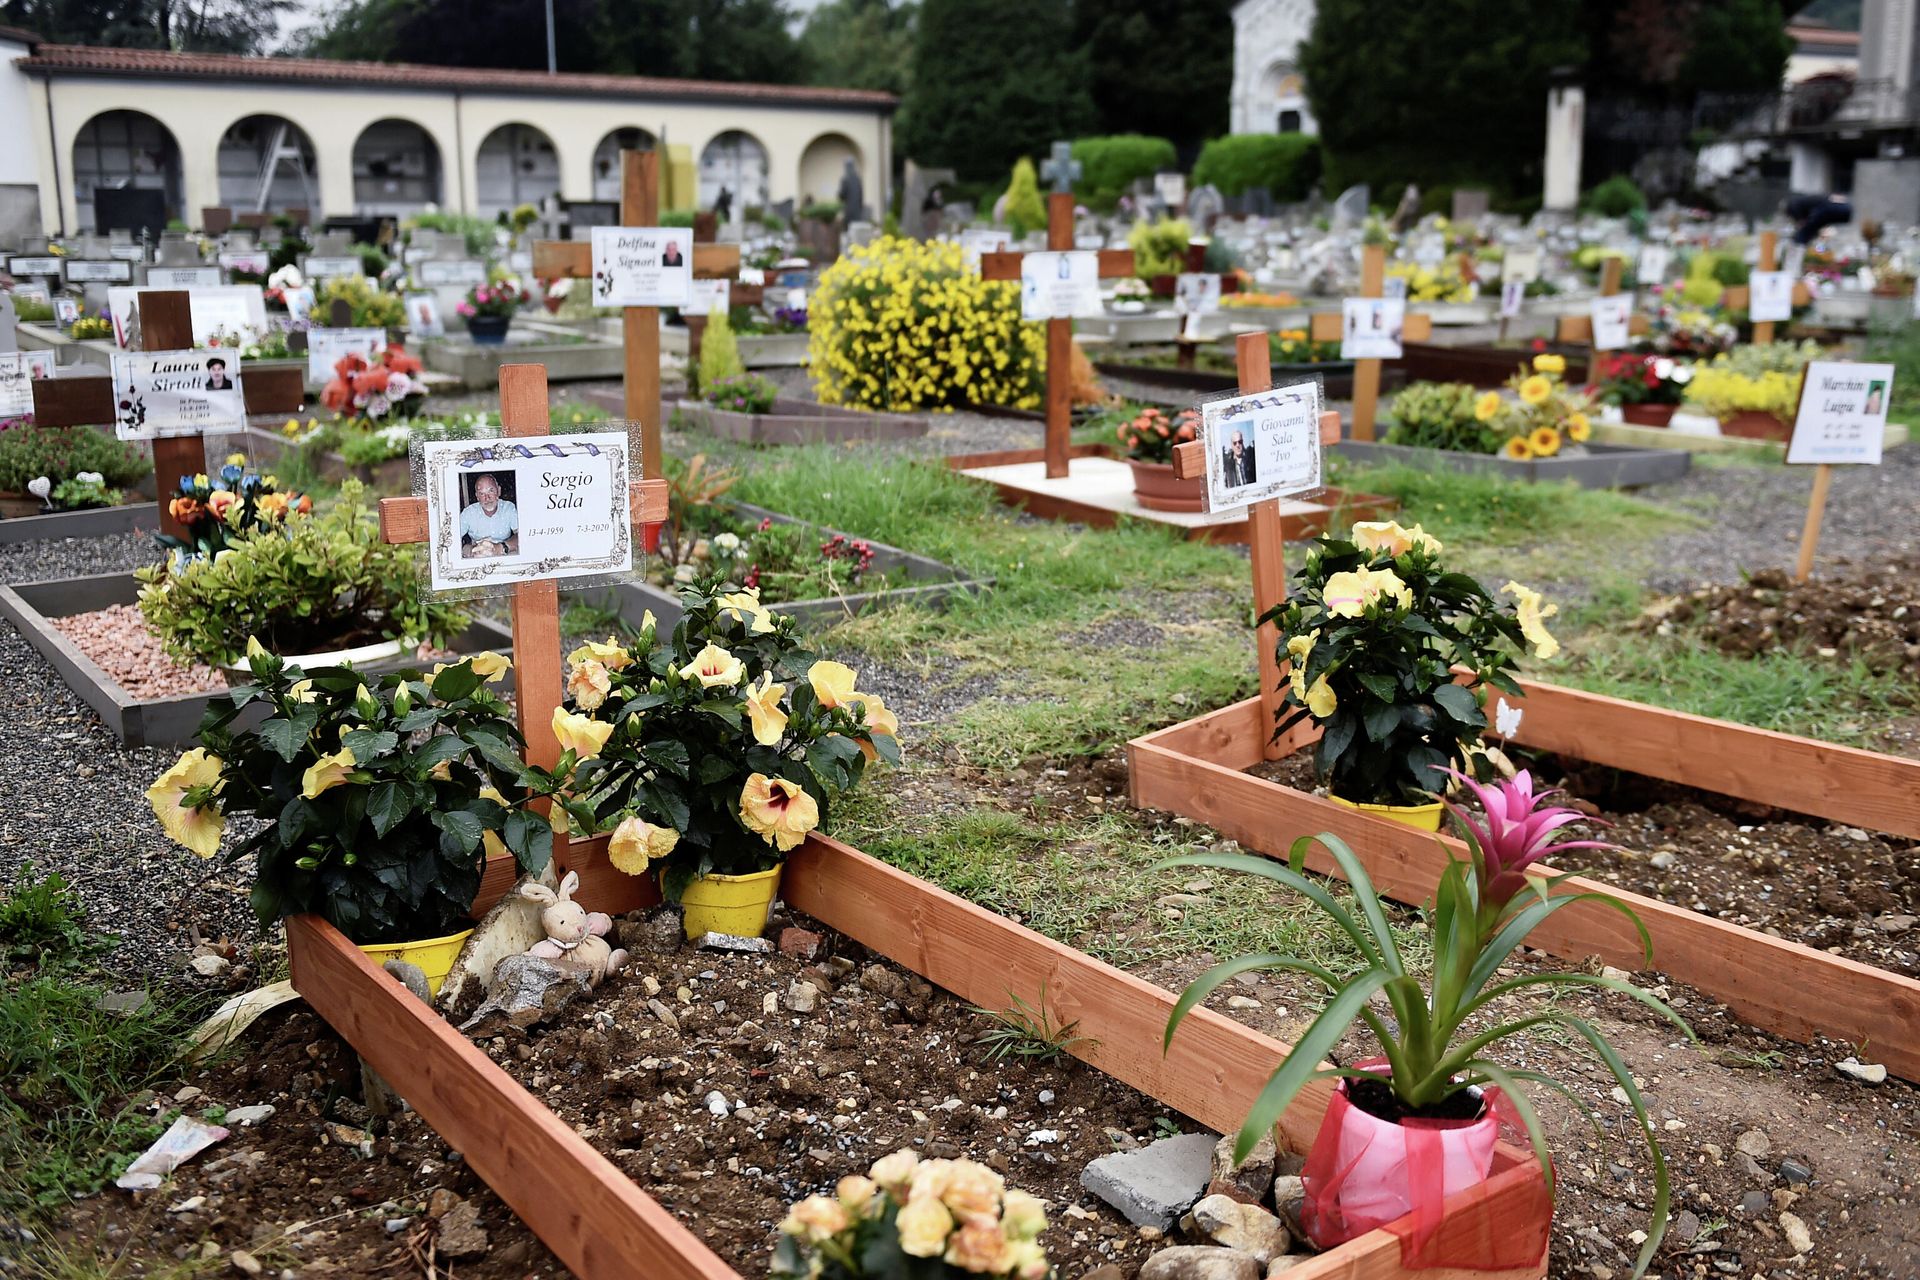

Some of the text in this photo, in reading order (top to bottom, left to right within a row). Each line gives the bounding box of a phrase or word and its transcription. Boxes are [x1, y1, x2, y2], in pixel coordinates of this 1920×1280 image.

[152, 361, 200, 374] Laura
[152, 377, 201, 392] Sirtoli
[1261, 413, 1305, 431] Giovanni
[1272, 431, 1293, 446] Sala
[540, 471, 593, 490] Sergio
[546, 493, 584, 510] Sala
[528, 523, 610, 537] 13-4-1959 7-3-2020
